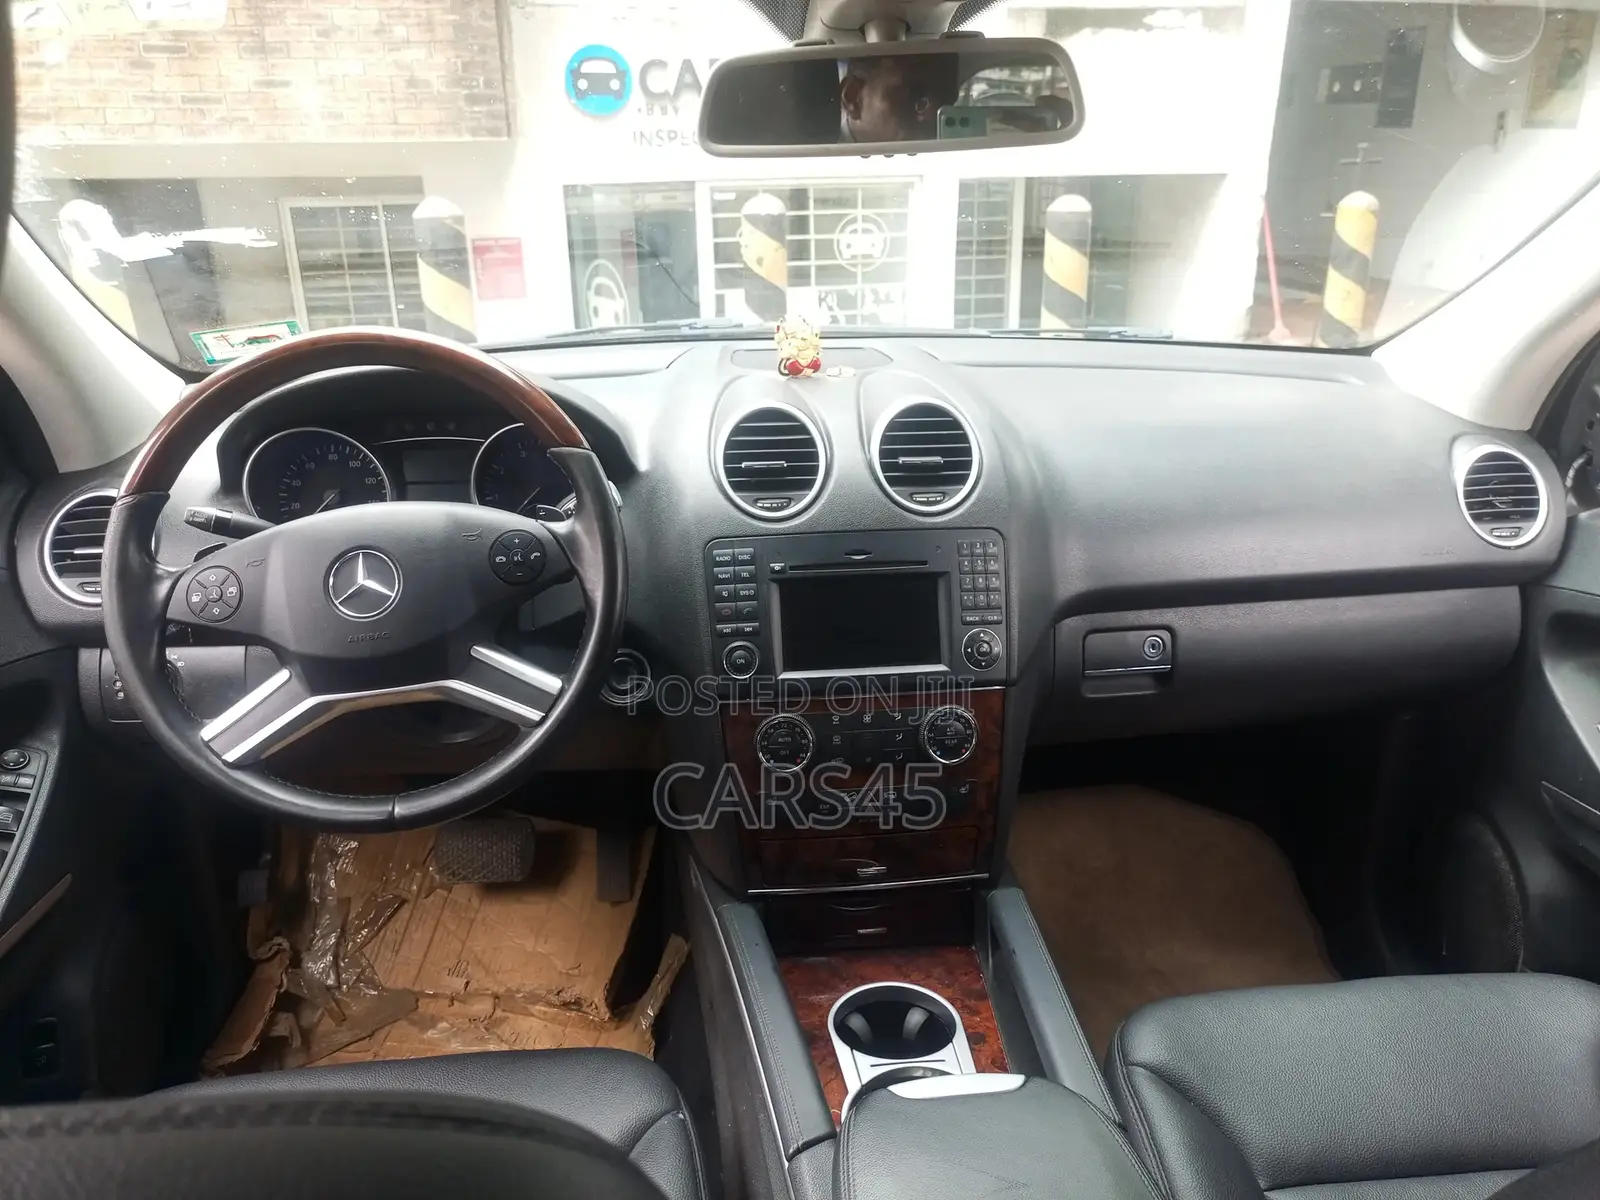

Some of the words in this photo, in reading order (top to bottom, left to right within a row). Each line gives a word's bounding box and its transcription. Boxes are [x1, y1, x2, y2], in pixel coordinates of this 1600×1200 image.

[639, 58, 719, 101] CA
[305, 461, 316, 469] 60
[349, 460, 361, 468] 100
[291, 479, 302, 487] 40
